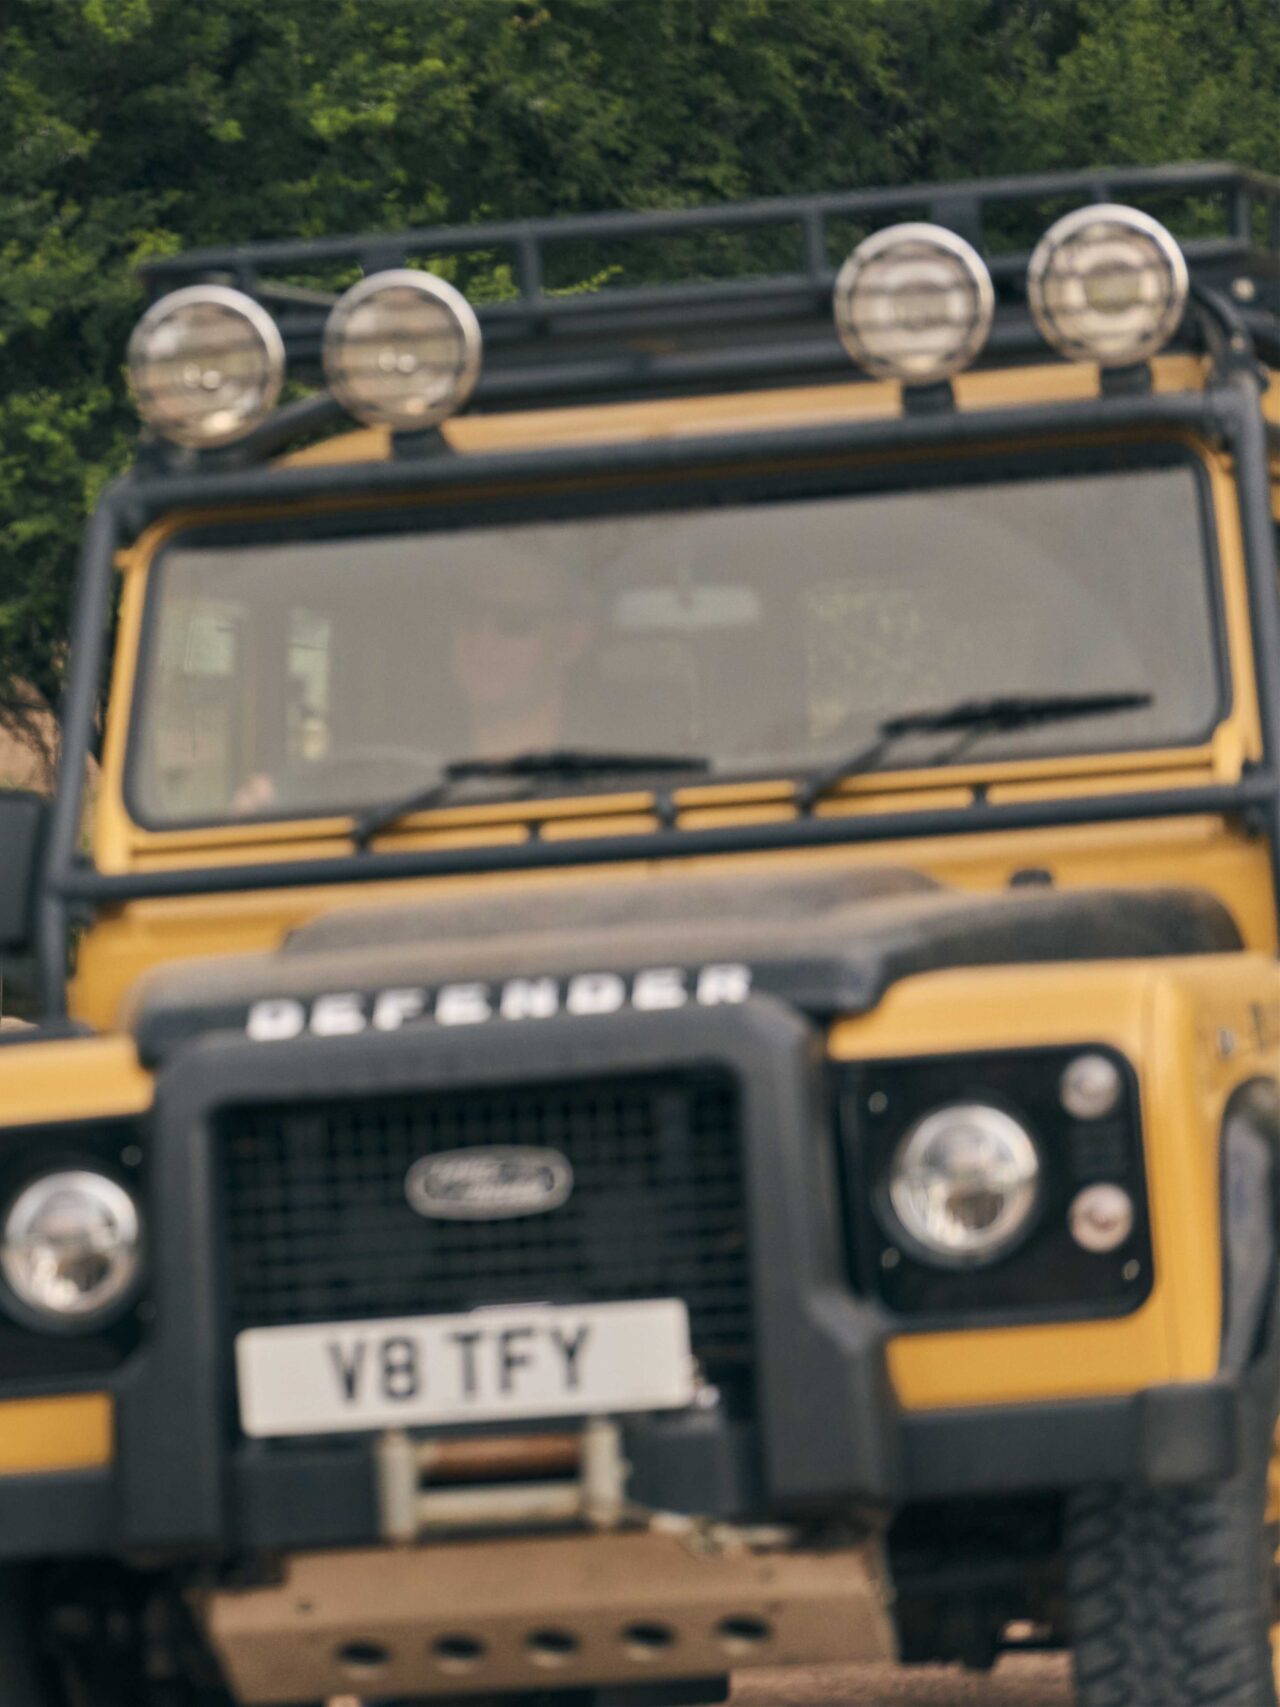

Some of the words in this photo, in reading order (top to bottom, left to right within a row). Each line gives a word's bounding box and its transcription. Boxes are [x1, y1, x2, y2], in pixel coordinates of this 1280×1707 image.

[245, 963, 754, 1043] DEFENDER
[328, 1335, 421, 1405] V8
[449, 1324, 592, 1397] TFY
